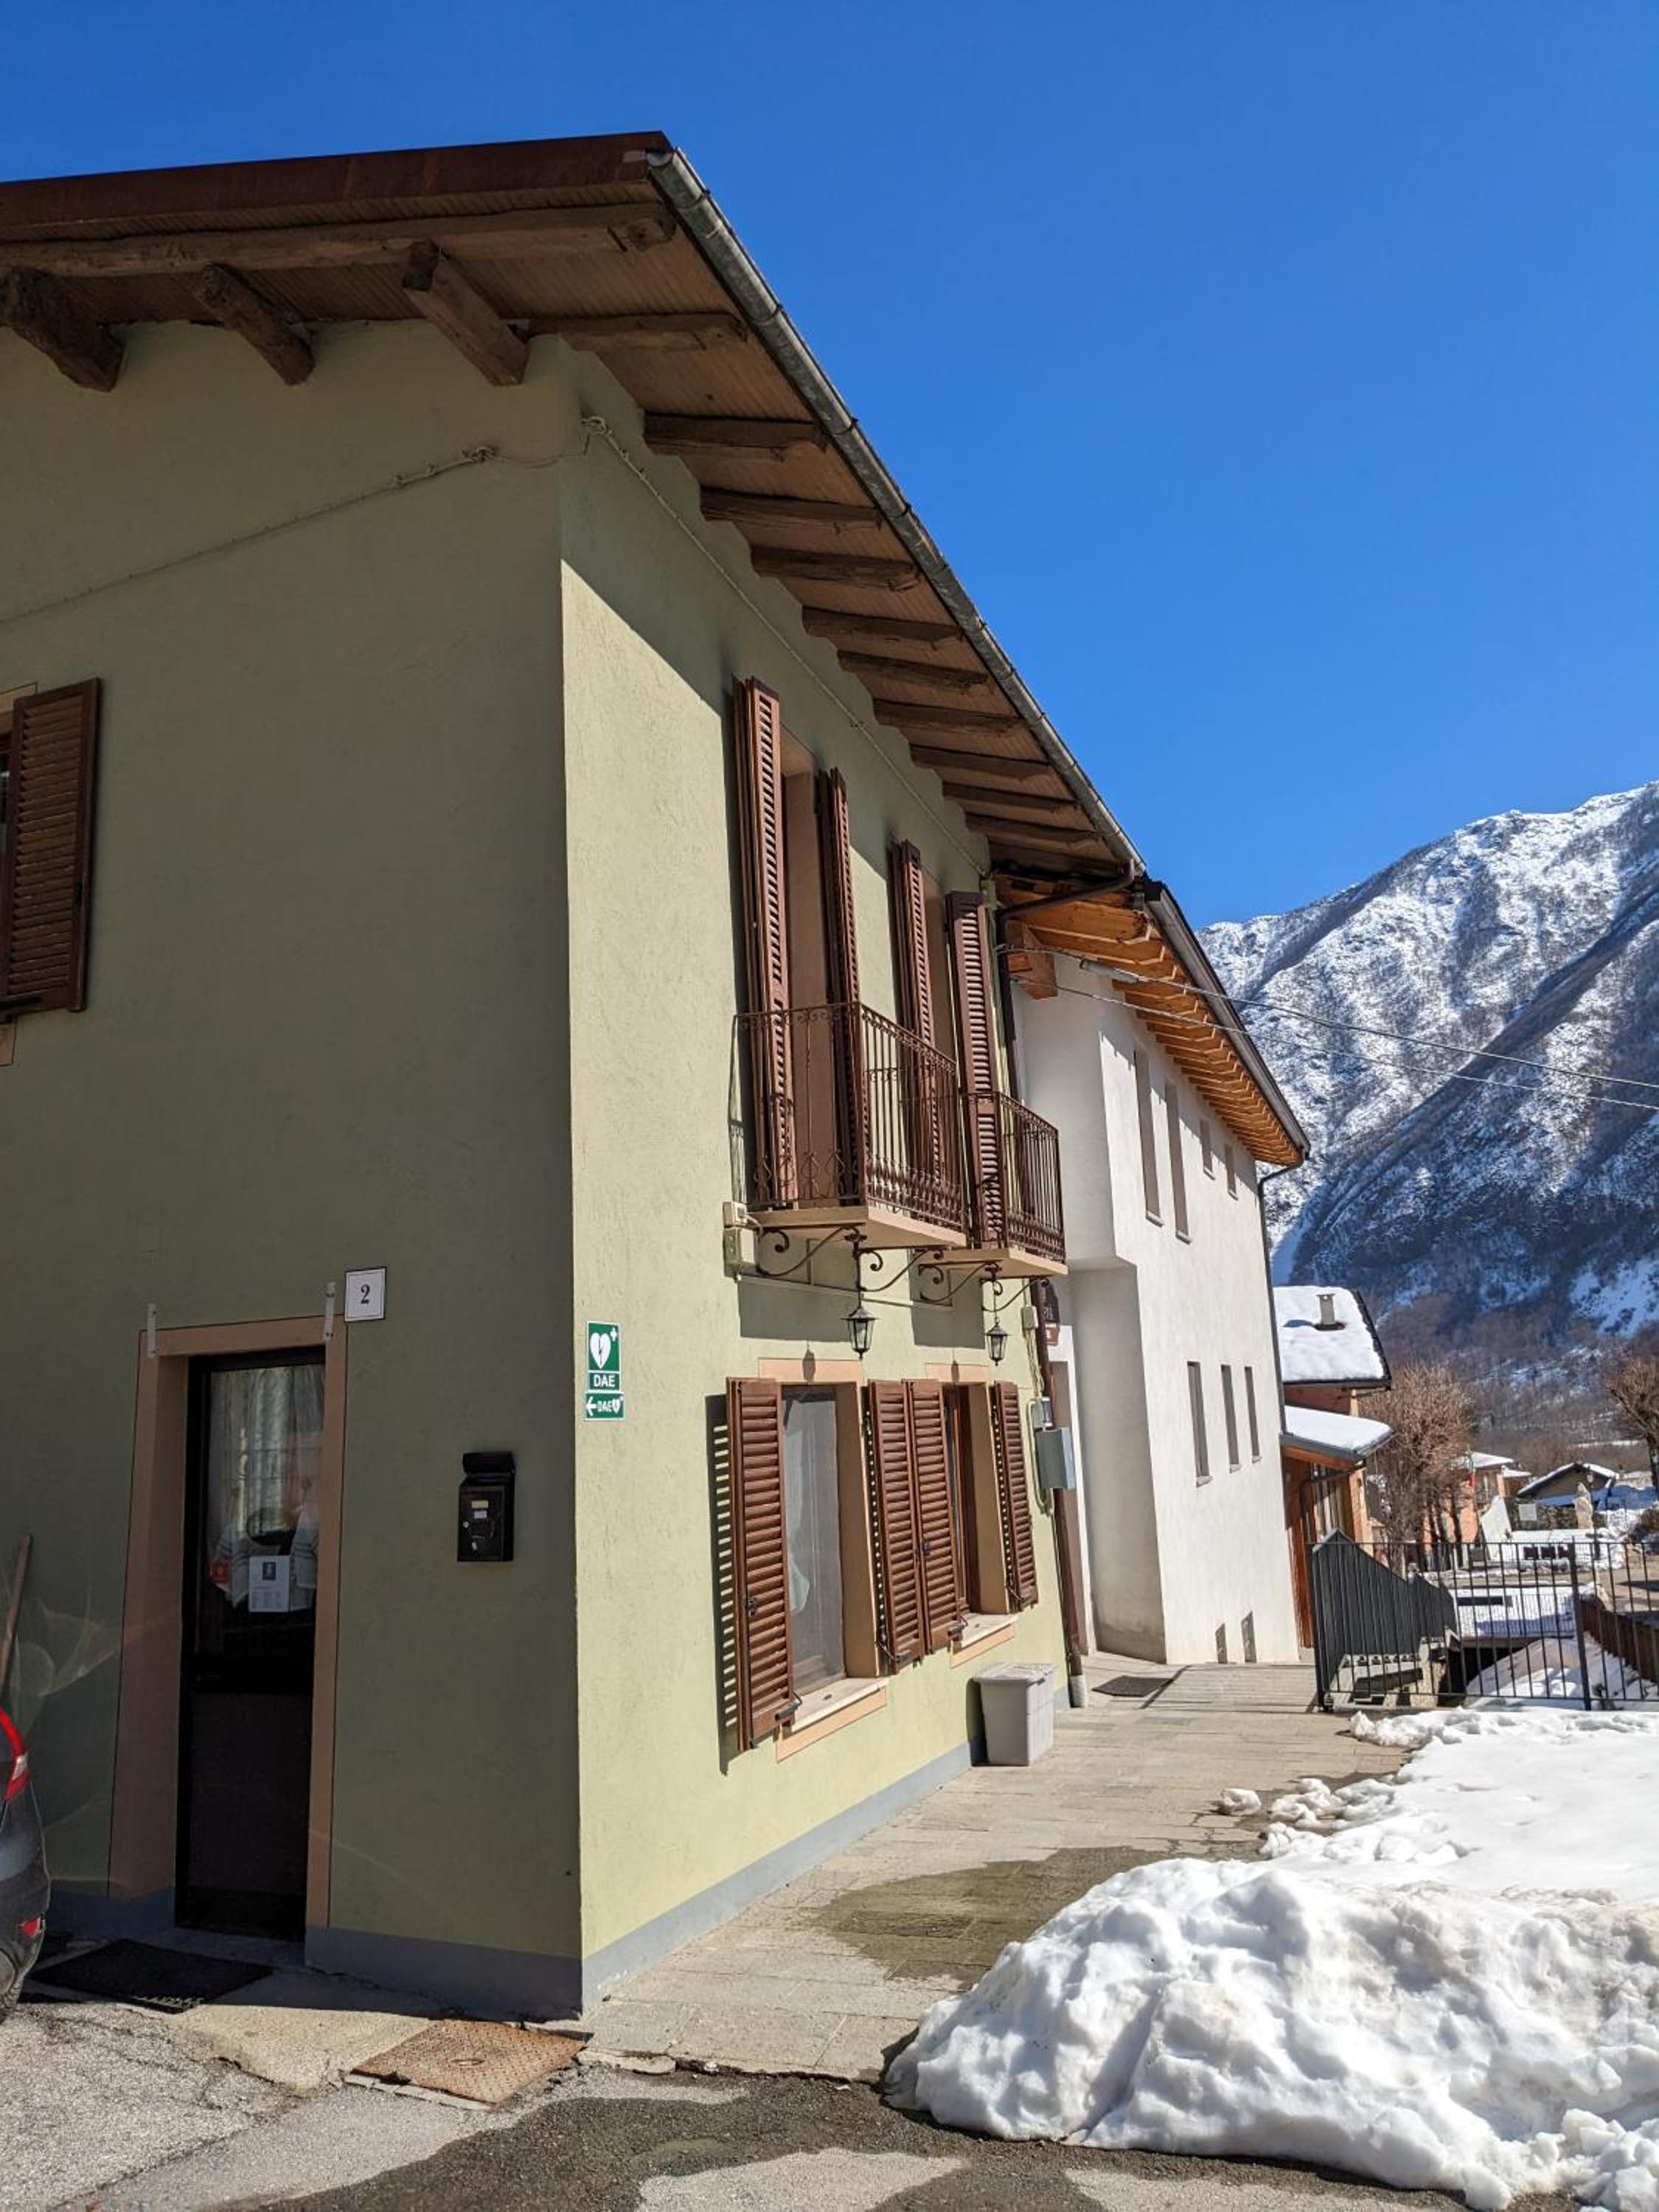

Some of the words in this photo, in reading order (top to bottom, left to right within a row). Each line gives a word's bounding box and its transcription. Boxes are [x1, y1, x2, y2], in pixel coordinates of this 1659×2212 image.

[361, 1284, 370, 1304] 2
[594, 1374, 615, 1388] DAE
[597, 1399, 613, 1413] DAE
